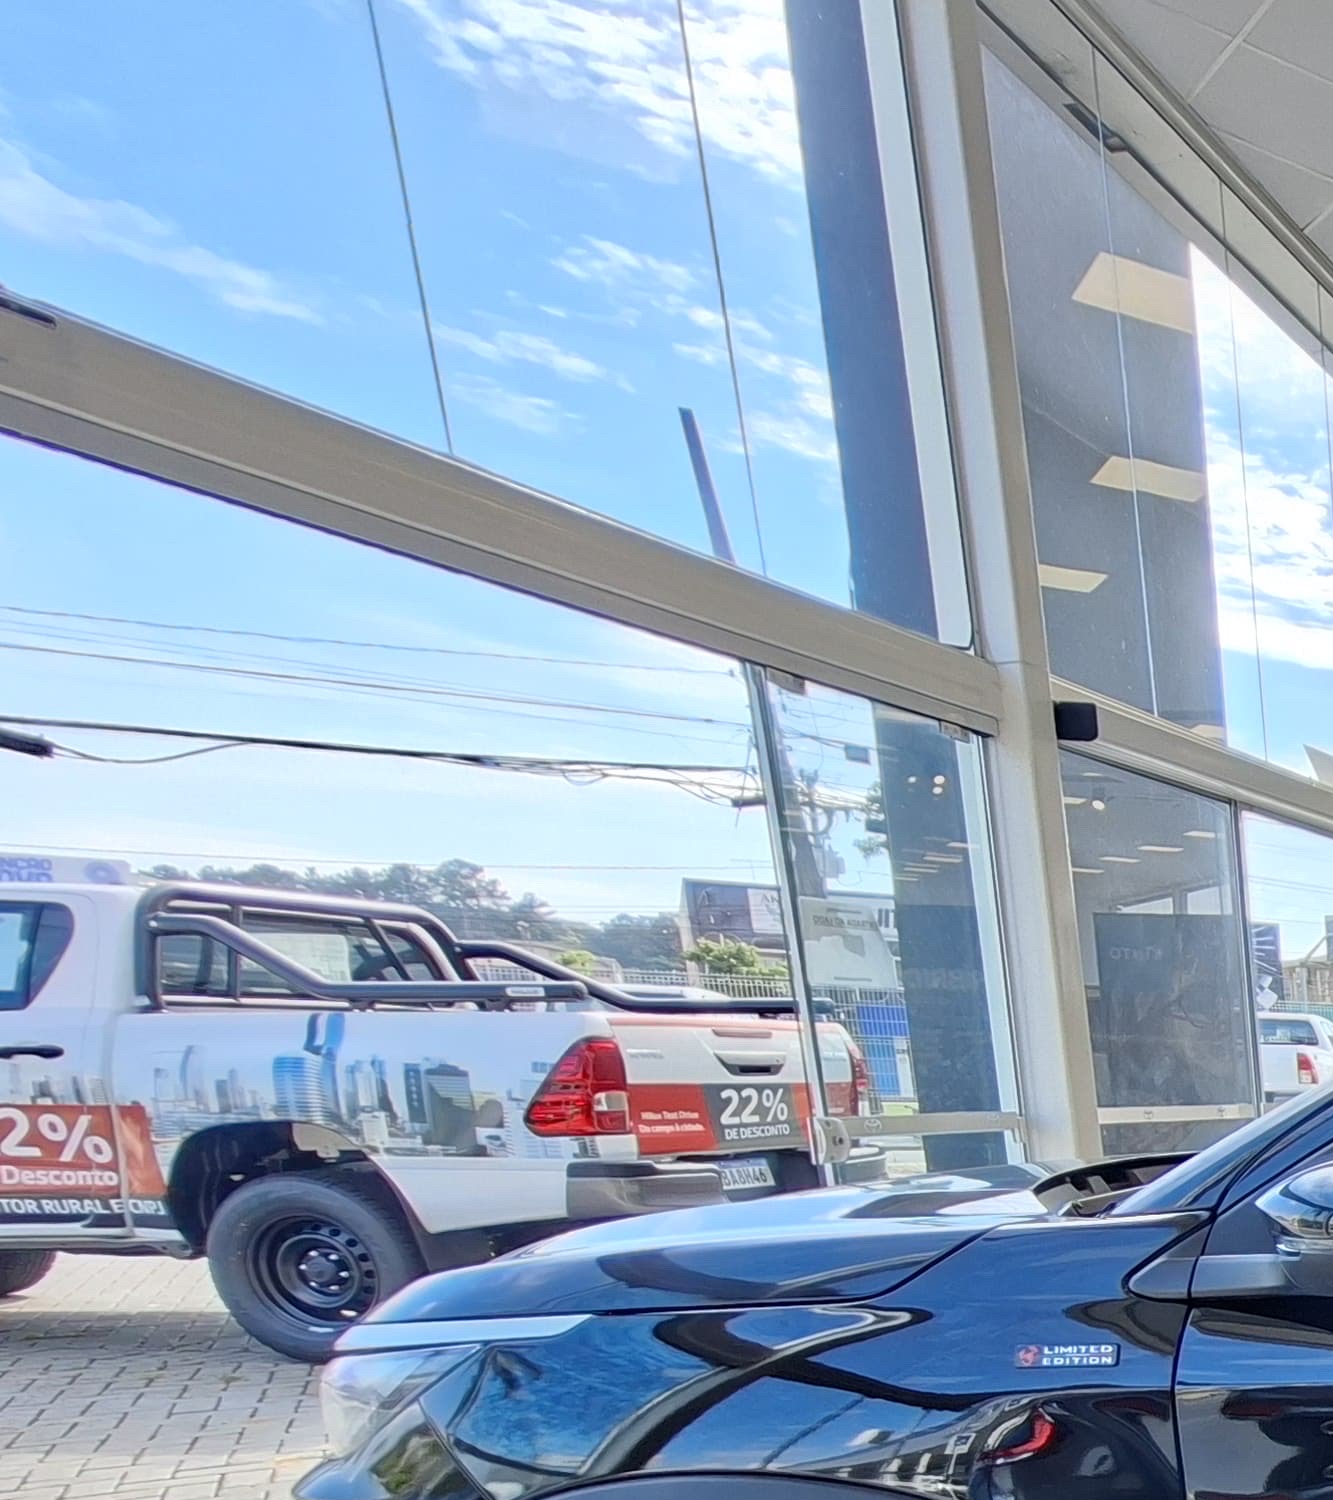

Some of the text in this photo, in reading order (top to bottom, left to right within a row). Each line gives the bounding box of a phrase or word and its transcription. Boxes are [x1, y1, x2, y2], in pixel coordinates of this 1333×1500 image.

[720, 1088, 788, 1126] 22%
[725, 1124, 790, 1139] DE DESCONTO
[2, 1165, 118, 1185] Desconto
[40, 1199, 109, 1214] RURAL
[1044, 1345, 1113, 1354] LIMITED
[1042, 1356, 1112, 1365] EDITION
